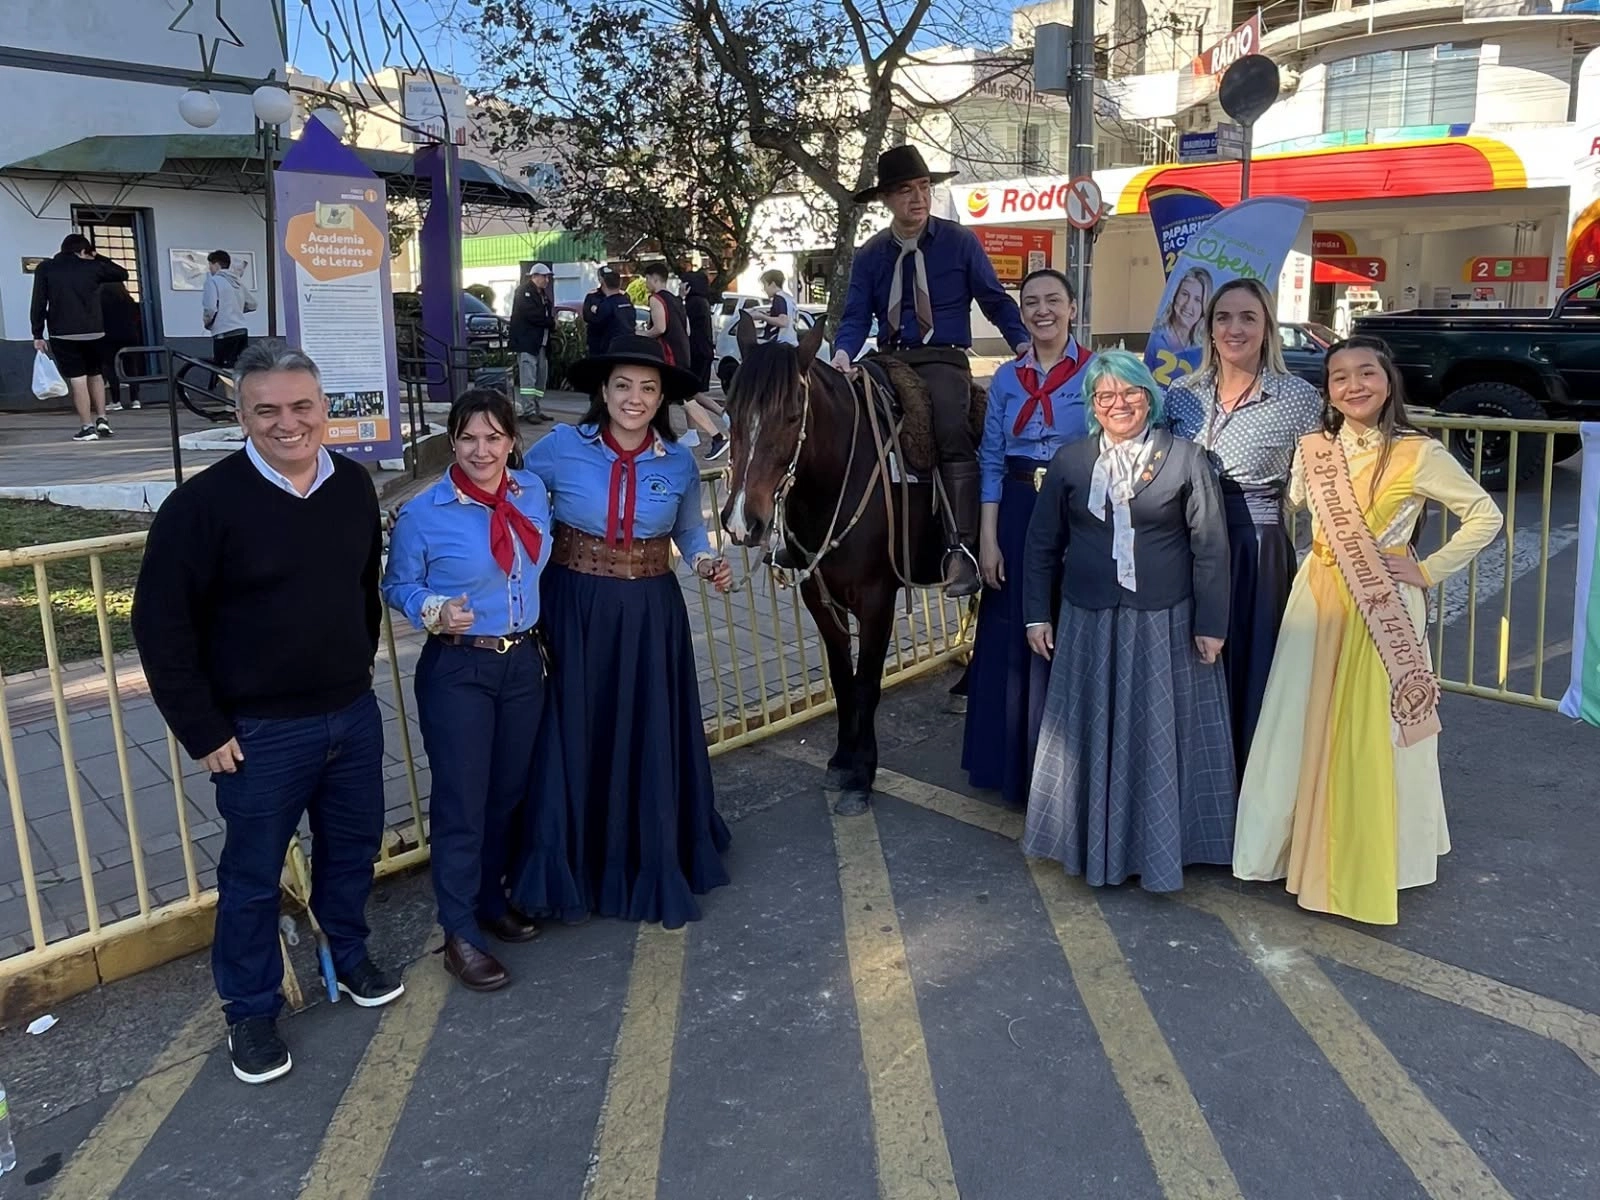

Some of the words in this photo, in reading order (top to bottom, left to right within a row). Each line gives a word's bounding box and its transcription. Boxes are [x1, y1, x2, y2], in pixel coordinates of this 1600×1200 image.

[308, 232, 364, 245] Academia
[300, 244, 373, 256] Soledadense
[312, 256, 326, 266] de
[329, 257, 364, 268] Letras
[1368, 262, 1380, 277] 3
[1477, 262, 1489, 277] 2
[1314, 464, 1353, 527] Prenda
[1335, 529, 1384, 588] Juvenil
